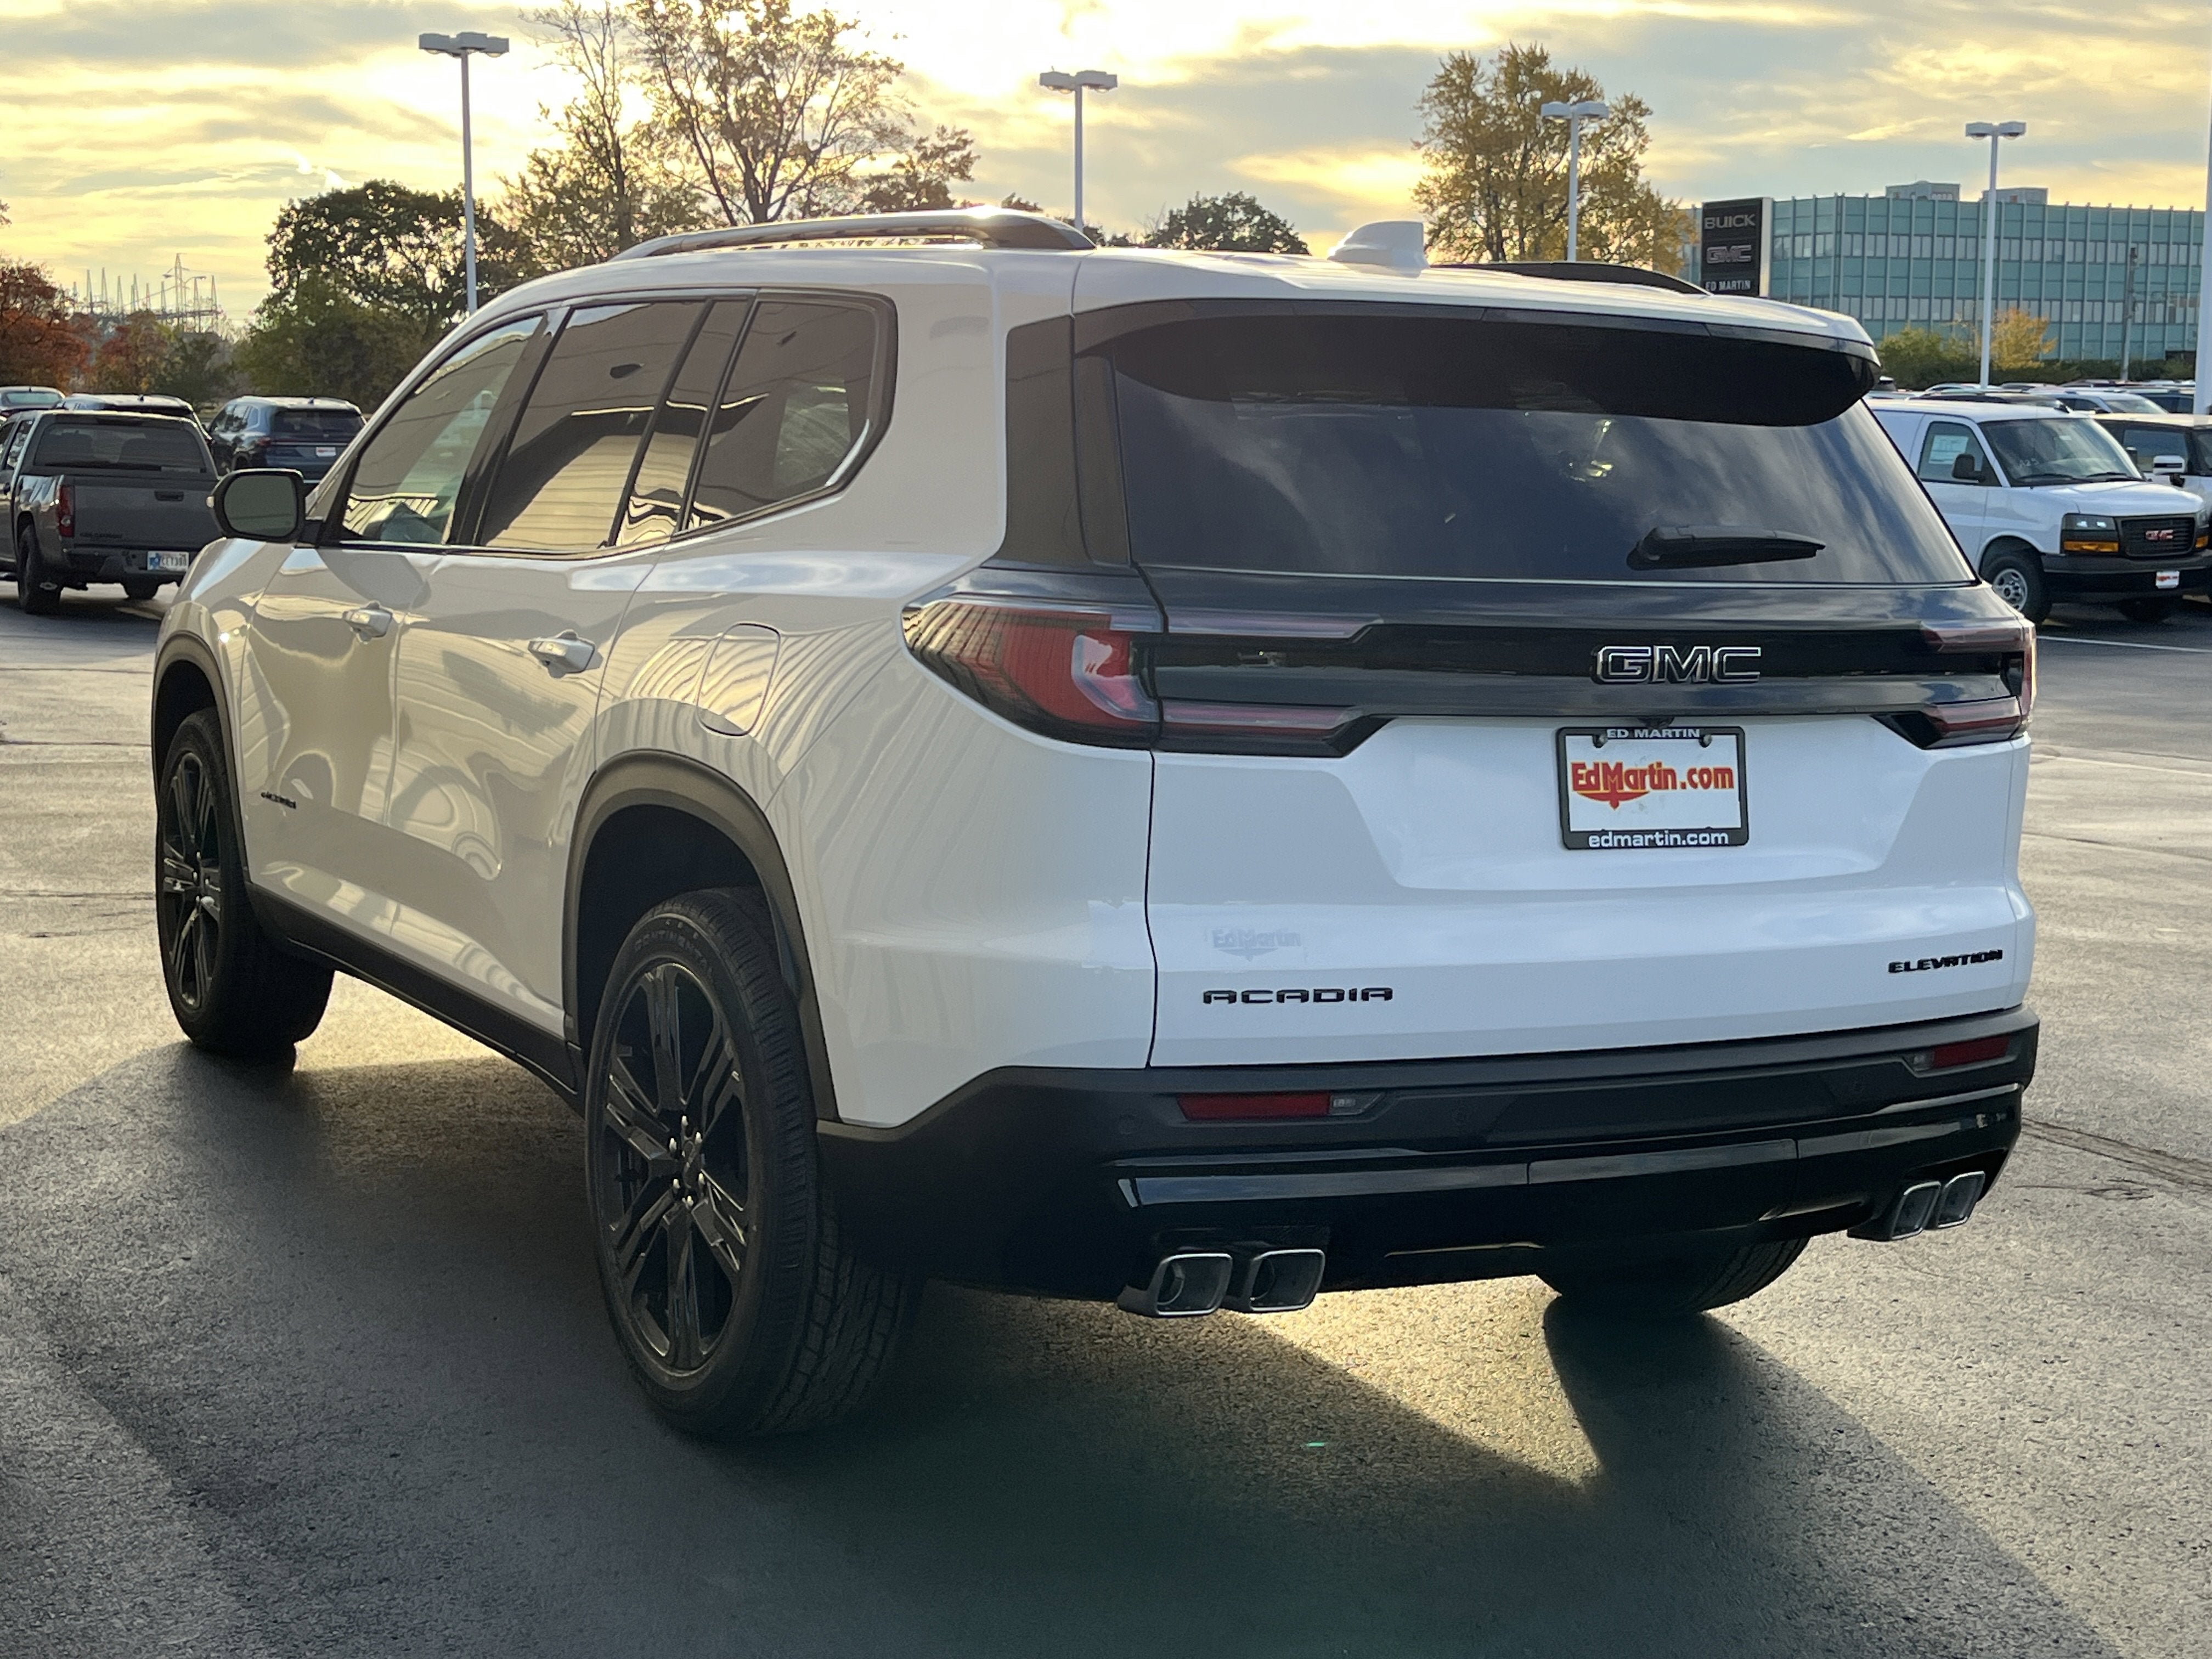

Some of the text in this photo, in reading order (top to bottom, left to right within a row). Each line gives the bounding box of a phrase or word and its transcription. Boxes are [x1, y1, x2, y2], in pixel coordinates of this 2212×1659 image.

[1703, 215, 1756, 229] BUICK
[1707, 245, 1752, 263] GMC
[1706, 280, 1751, 291] ED MARTIN
[1595, 646, 1762, 683] GMC
[1606, 729, 1700, 738] ED MARTIN
[1588, 830, 1729, 848] edmartin.com
[1888, 950, 2003, 973] ELEVATION
[1203, 988, 1393, 1004] ACADIA
